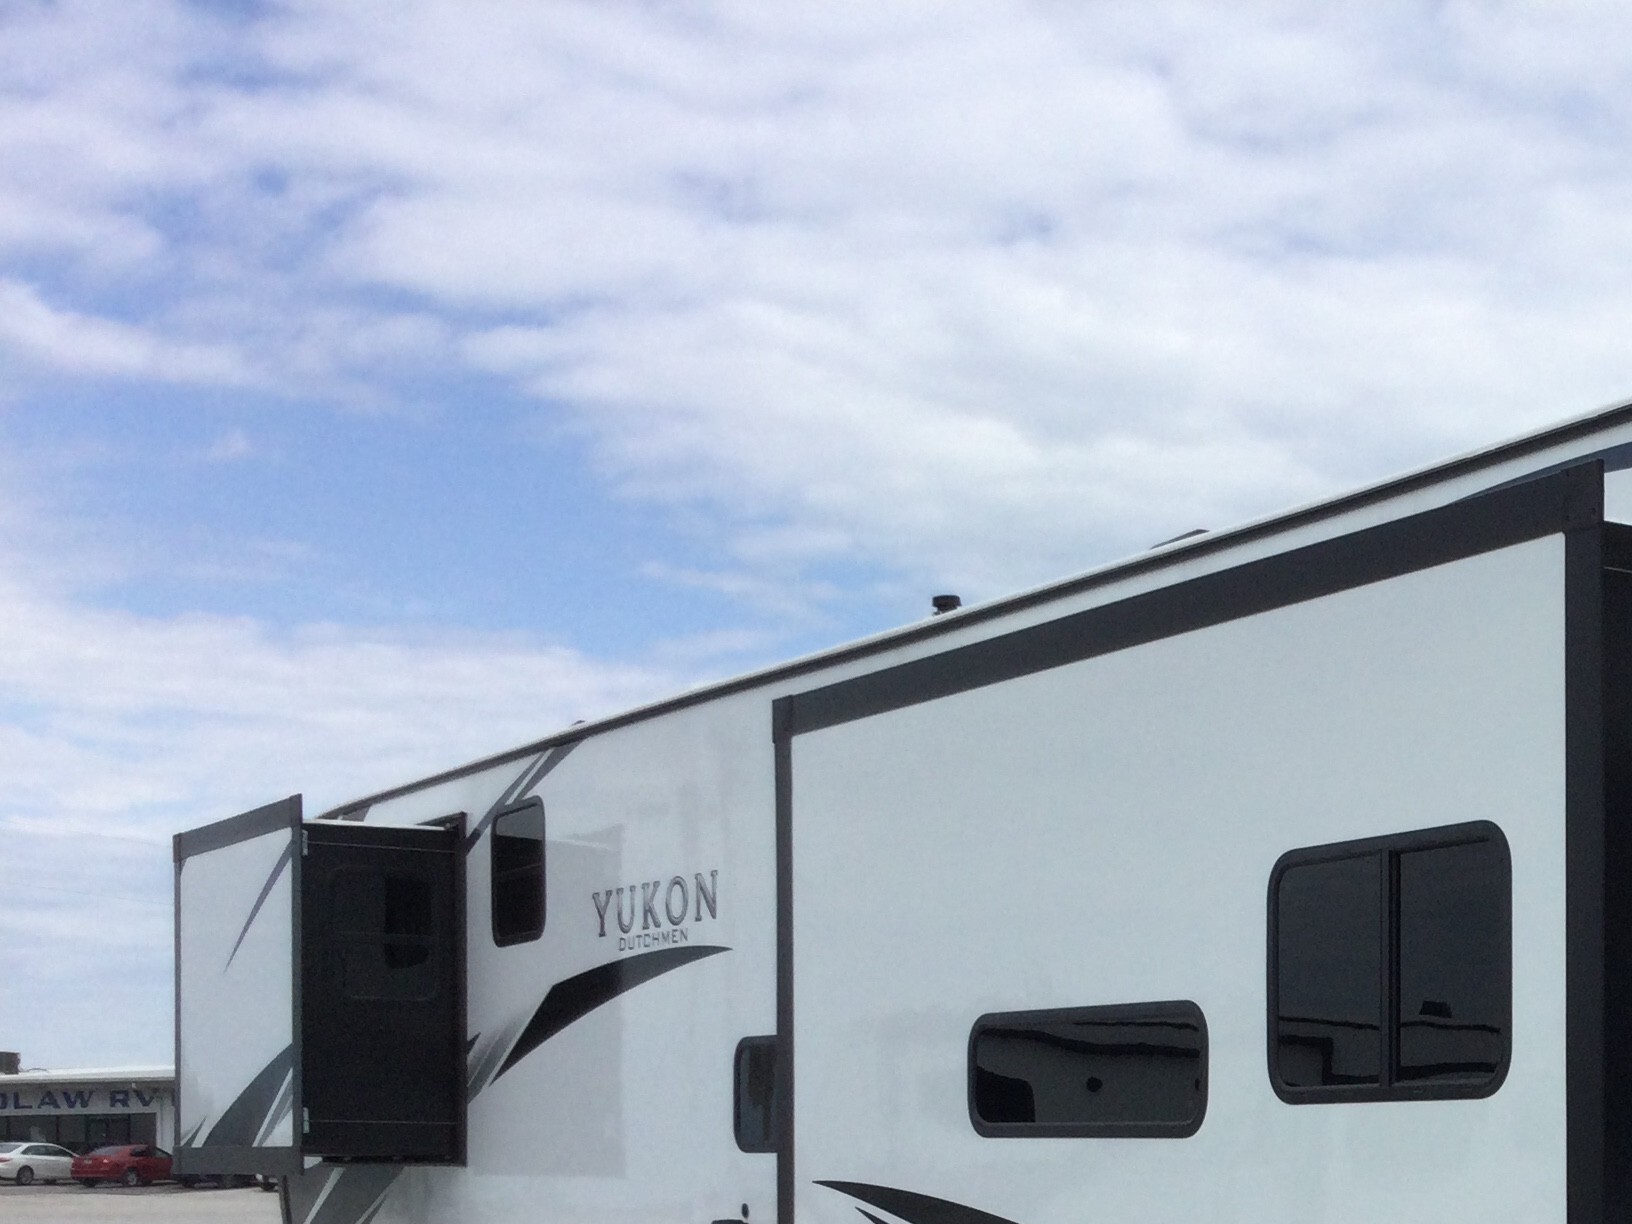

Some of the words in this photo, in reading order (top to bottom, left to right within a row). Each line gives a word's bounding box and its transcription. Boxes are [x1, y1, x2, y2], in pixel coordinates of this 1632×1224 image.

[591, 869, 719, 938] YUKON
[618, 927, 689, 952] DUTCHMEN
[109, 1089, 156, 1108] RV
